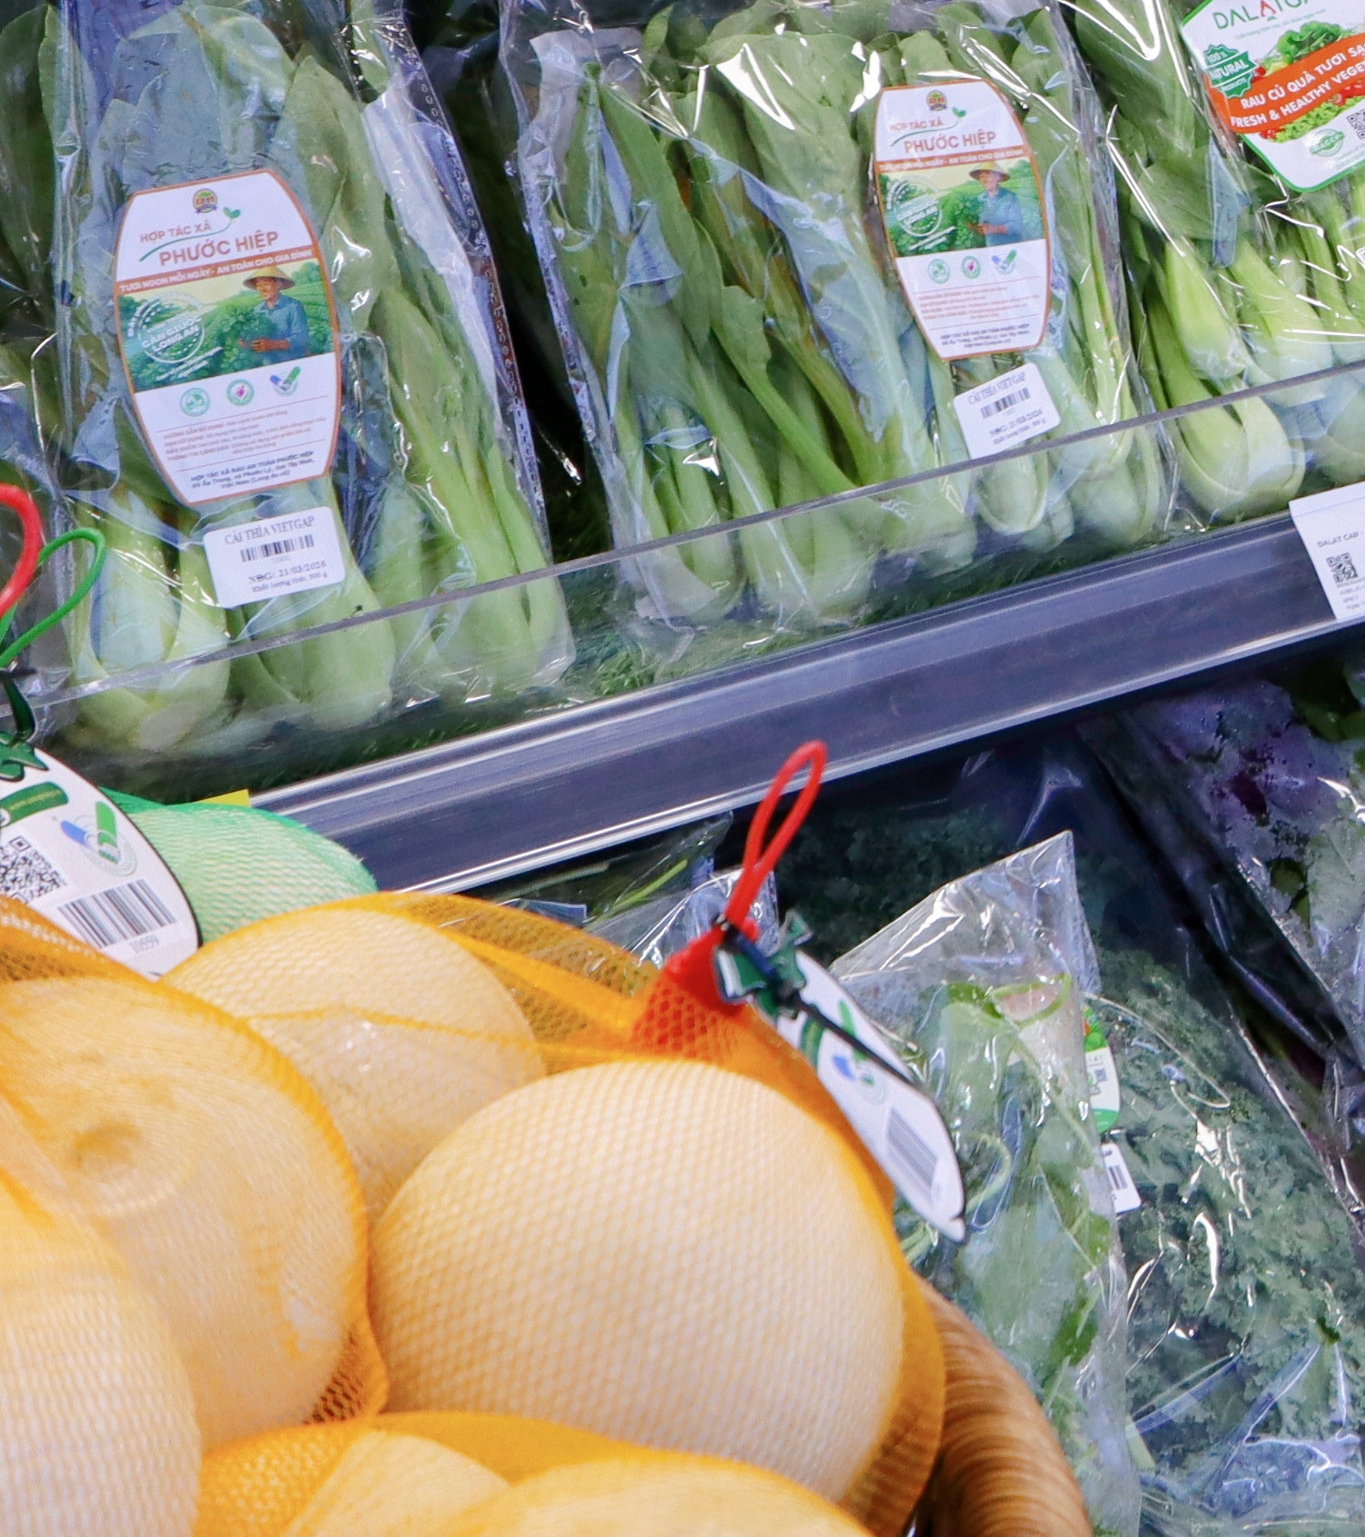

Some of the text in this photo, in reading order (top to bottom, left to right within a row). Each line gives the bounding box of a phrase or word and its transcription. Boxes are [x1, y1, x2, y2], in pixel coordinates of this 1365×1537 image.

[1240, 93, 1266, 110] RAU
[1315, 53, 1347, 75] TƯƠI
[1230, 114, 1268, 128] FRESH
[1269, 109, 1281, 121] &
[1282, 81, 1332, 116] HEALTHY
[903, 128, 997, 153] PHƯỚC HIỆP
[140, 219, 212, 244] HỢP TÁC XÃ
[159, 230, 279, 266] PHƯỚC HIỆP
[271, 515, 315, 536] VIETGAP
